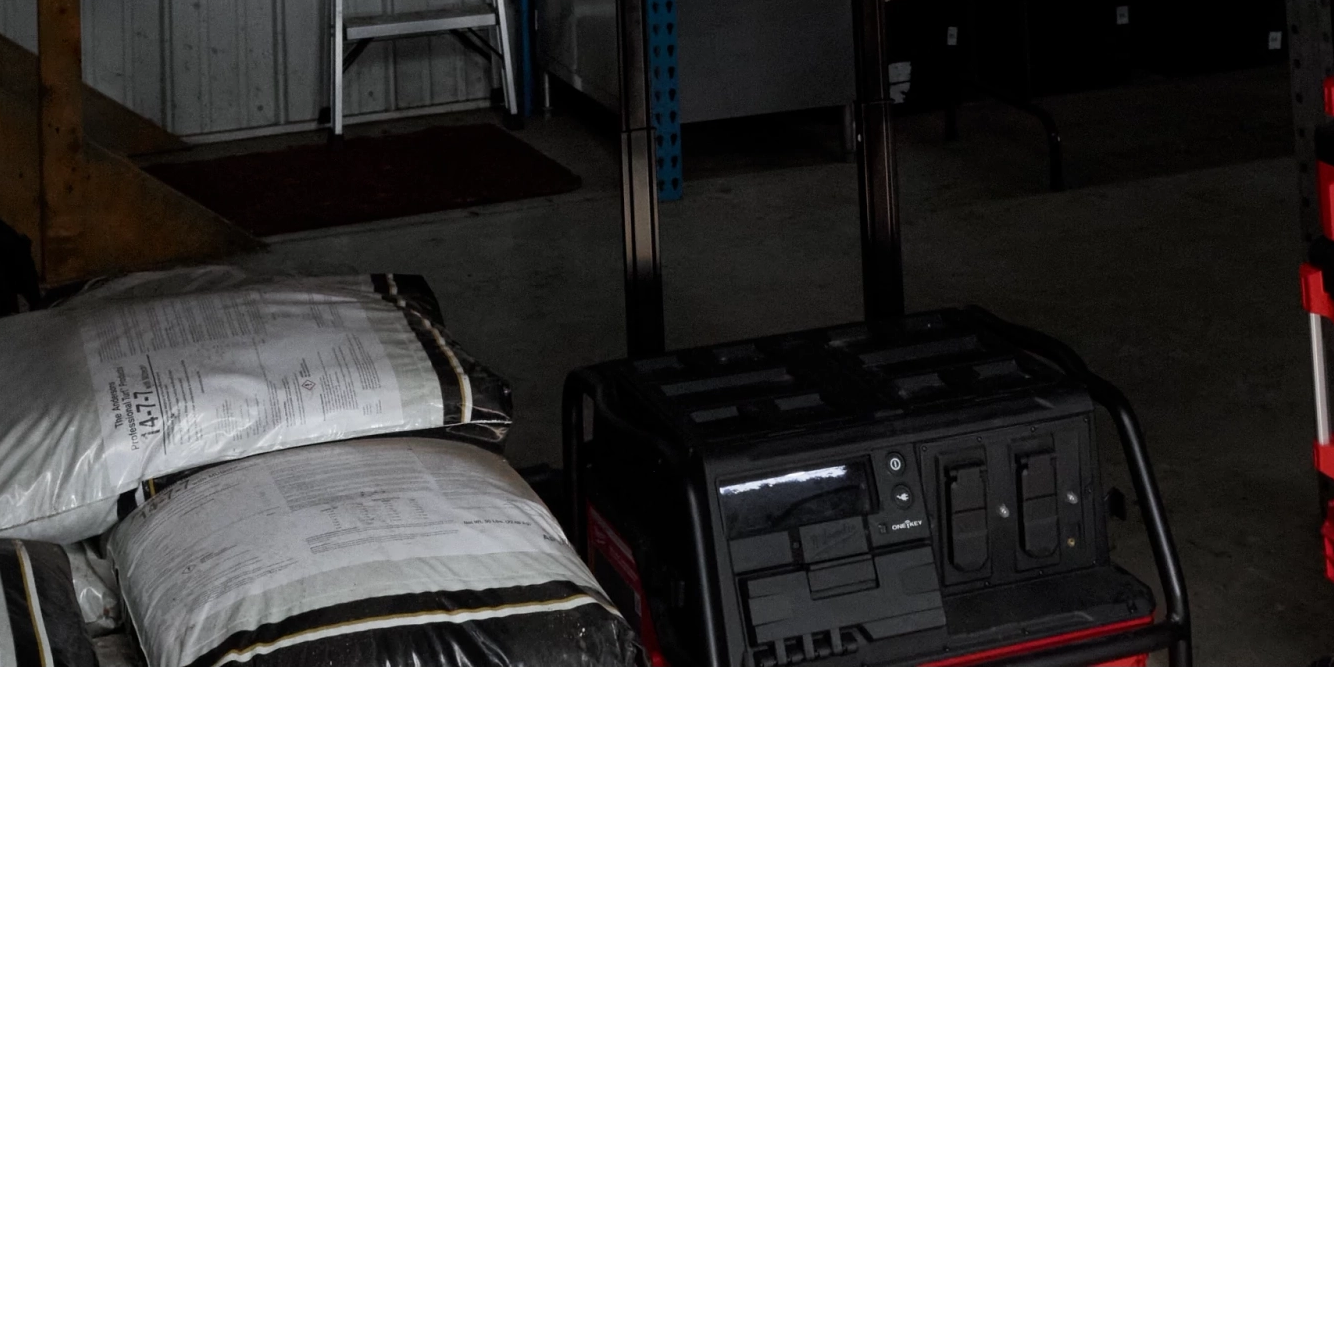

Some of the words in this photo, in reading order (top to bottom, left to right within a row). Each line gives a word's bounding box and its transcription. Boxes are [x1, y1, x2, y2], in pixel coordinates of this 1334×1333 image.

[109, 381, 121, 411] Andersons
[133, 391, 160, 439] 14-7-7
[115, 413, 123, 429] The
[124, 402, 139, 451] Professional
